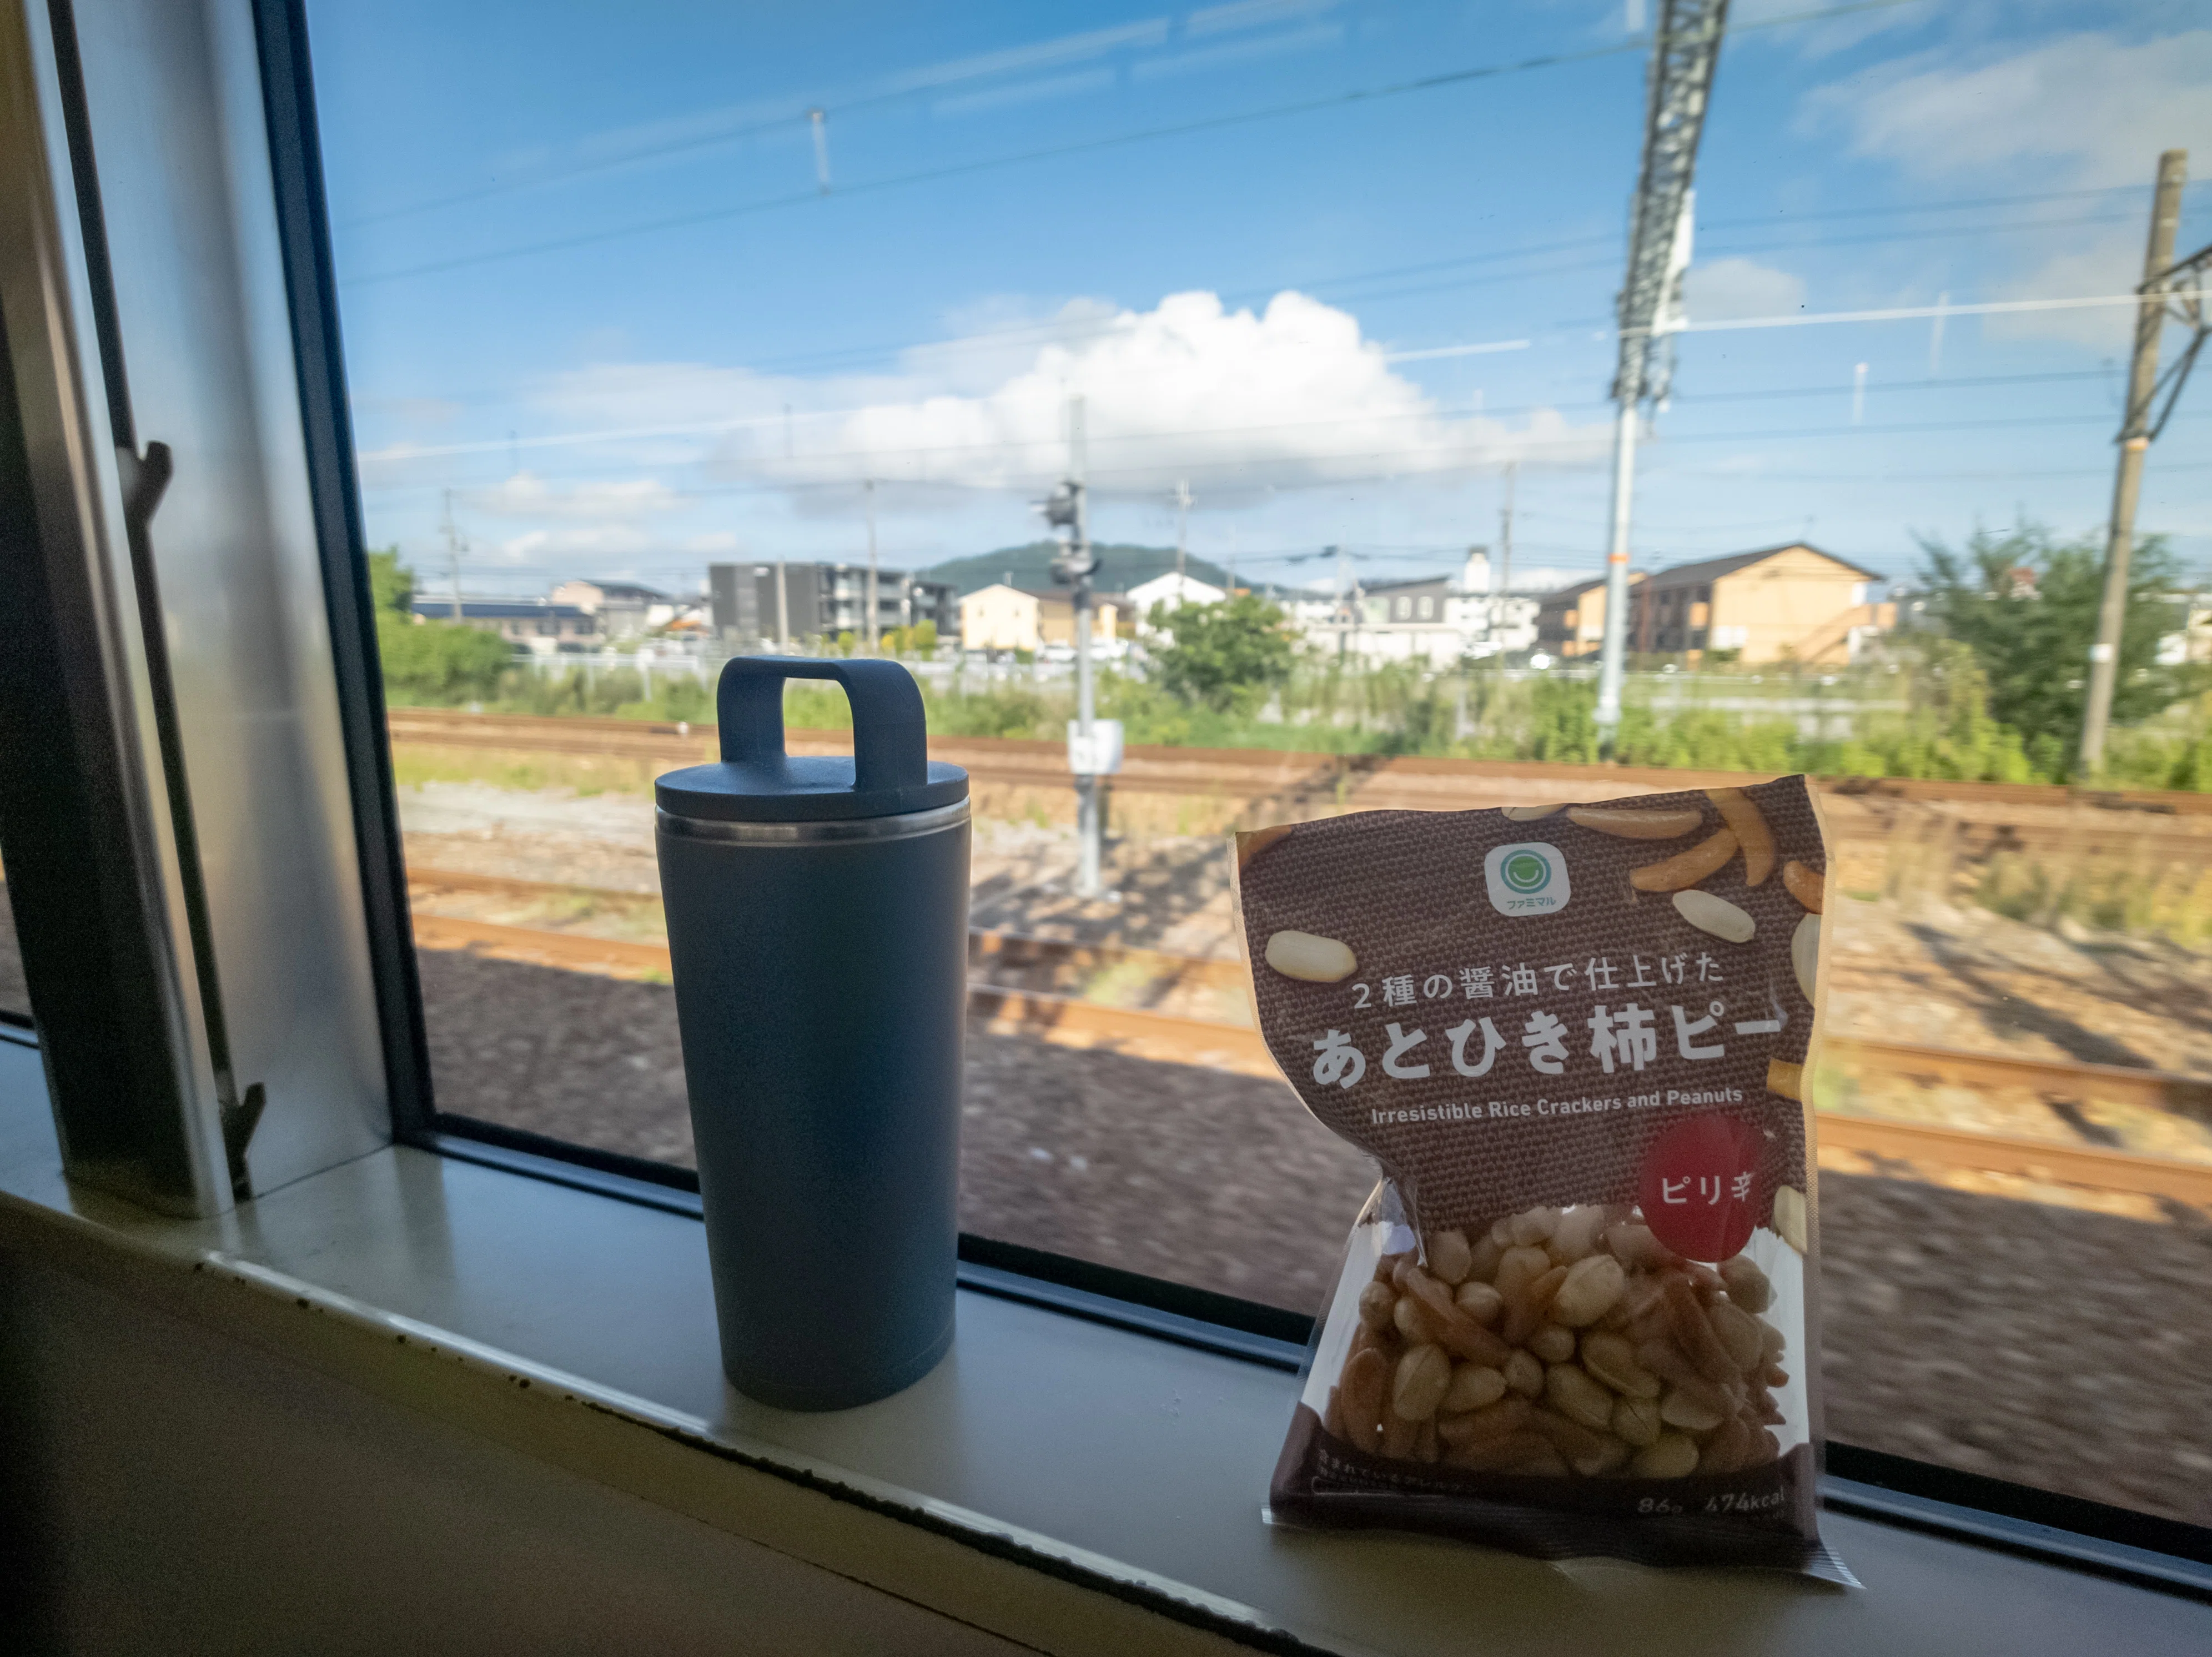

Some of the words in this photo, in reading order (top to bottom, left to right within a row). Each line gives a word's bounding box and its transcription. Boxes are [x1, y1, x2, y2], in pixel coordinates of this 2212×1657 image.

[1506, 896, 1556, 910] ファミマル
[1351, 951, 1723, 1009] 2種の醤油で仕上げた
[1313, 1000, 1781, 1089] あとひき柿ピー
[1371, 1102, 1482, 1124] Irresistible
[1489, 1099, 1531, 1118] Rice
[1537, 1097, 1621, 1115] Crackers
[1627, 1091, 1661, 1109] and
[1667, 1087, 1743, 1106] Peanuts
[1662, 1171, 1754, 1205] ピリ辛
